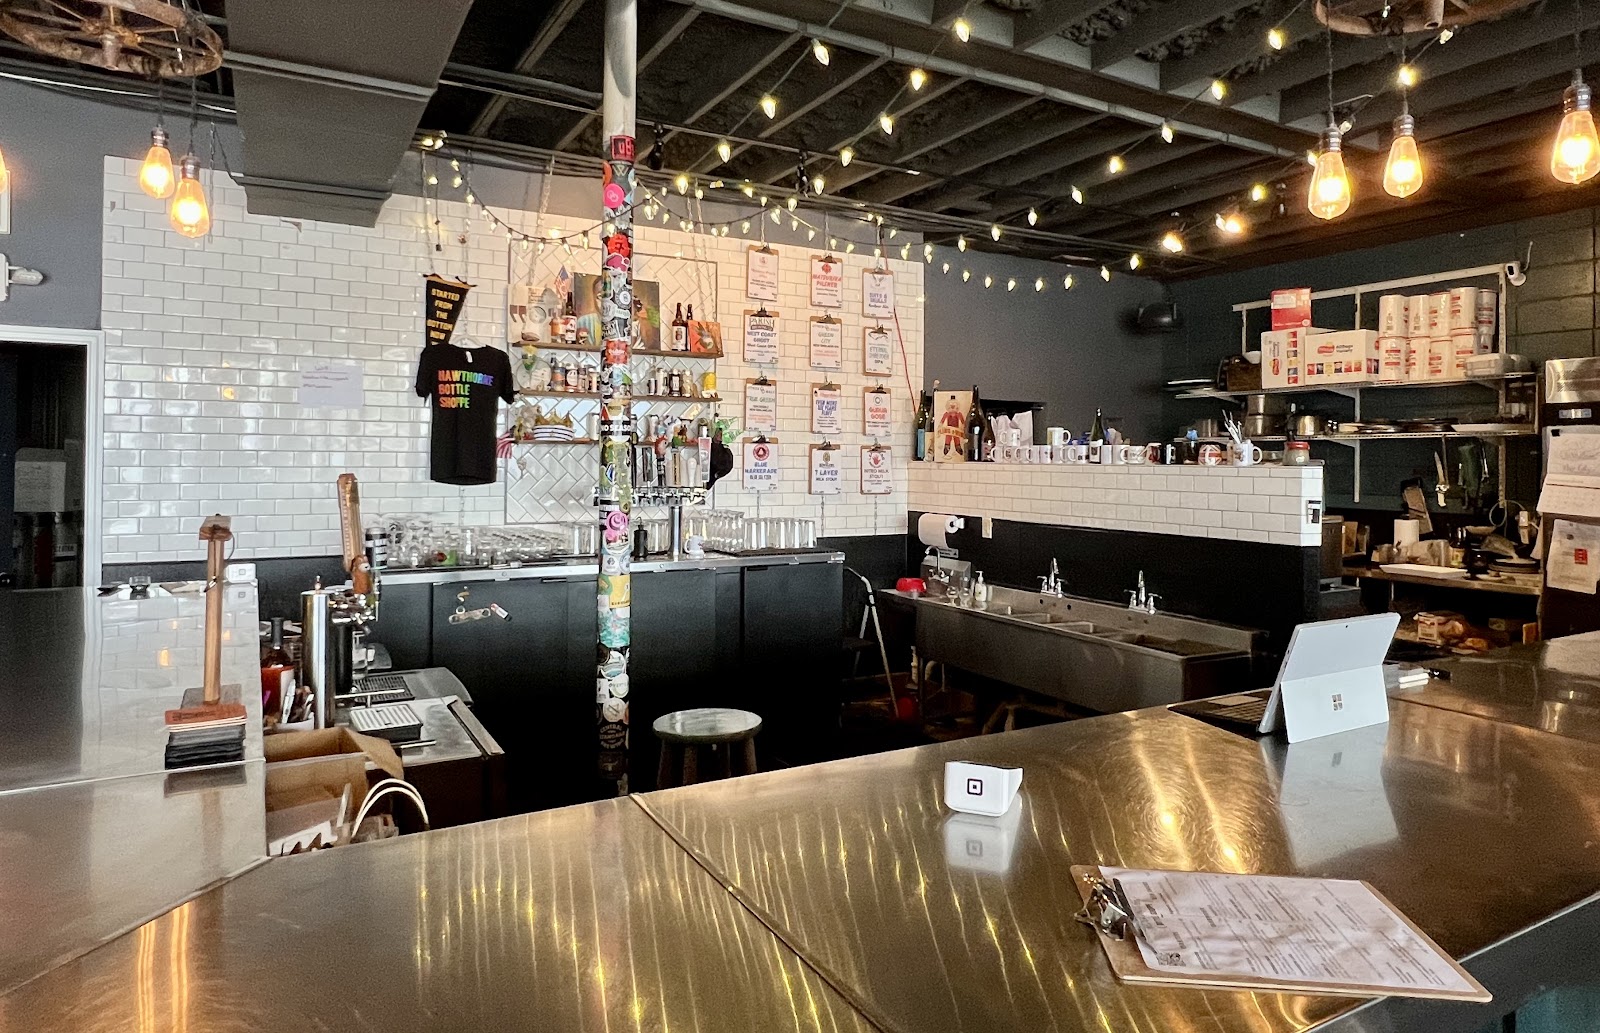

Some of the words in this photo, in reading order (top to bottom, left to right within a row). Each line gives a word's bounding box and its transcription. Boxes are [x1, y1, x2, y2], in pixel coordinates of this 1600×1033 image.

[431, 288, 460, 301] STARTED
[435, 300, 453, 311] FROM
[436, 310, 448, 320] THE
[427, 319, 453, 331] BOTTOM
[438, 370, 494, 386] HAWTHORNE
[438, 384, 471, 395] BOTTLE
[439, 396, 471, 409] SHOPPE
